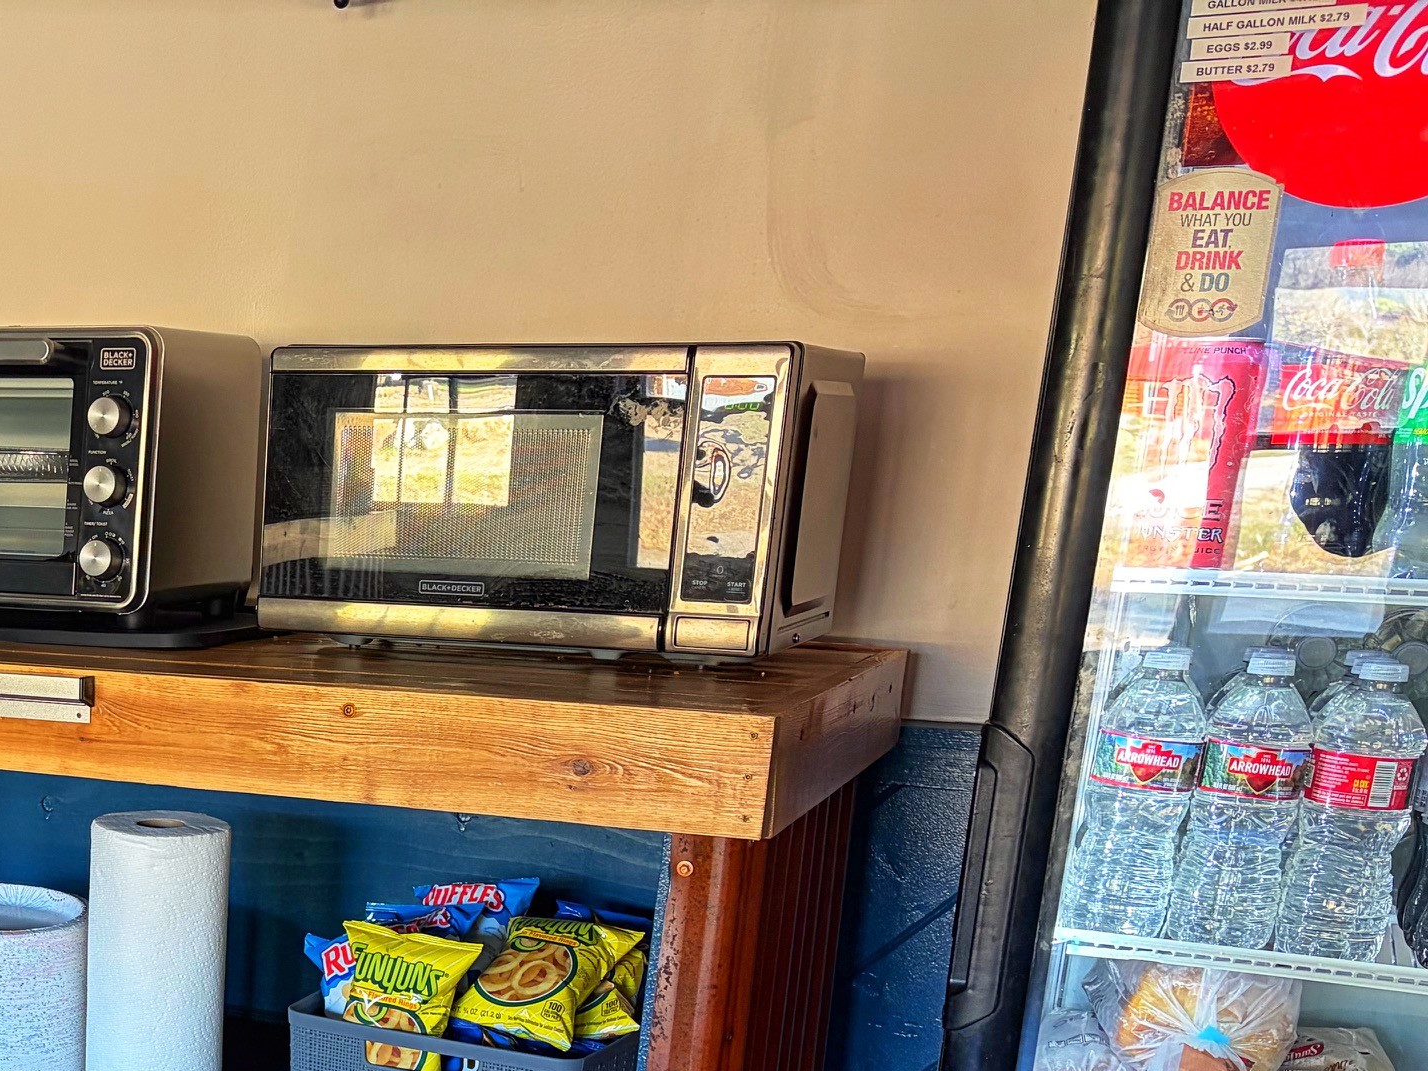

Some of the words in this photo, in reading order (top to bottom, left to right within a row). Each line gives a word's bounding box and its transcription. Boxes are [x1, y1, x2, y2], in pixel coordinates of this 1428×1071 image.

[1203, 21, 1233, 32] HALF
[1236, 17, 1285, 29] GALLON
[1288, 14, 1317, 25] MILK
[1319, 12, 1350, 23] $2.79
[1206, 43, 1240, 54] EGGS
[1243, 41, 1273, 51] $2.99
[1196, 65, 1242, 76] BUTTER
[1246, 63, 1275, 74] $2.79
[1168, 189, 1271, 212] BALANCE
[1180, 213, 1221, 227] WHAT
[1225, 212, 1253, 226] YOU
[1175, 250, 1244, 270] DRINK
[1180, 272, 1196, 292] &
[1199, 272, 1231, 292] DO
[1213, 347, 1247, 355] PUNCH
[103, 359, 133, 367] DECKER
[421, 583, 482, 593] BLACK+DECKER
[1117, 750, 1180, 768] ARROWHEAD
[1229, 760, 1292, 776] ARROWHEAD
[529, 930, 558, 941] Flavored
[398, 998, 417, 1010] Rings
[548, 1002, 563, 1012] 100
